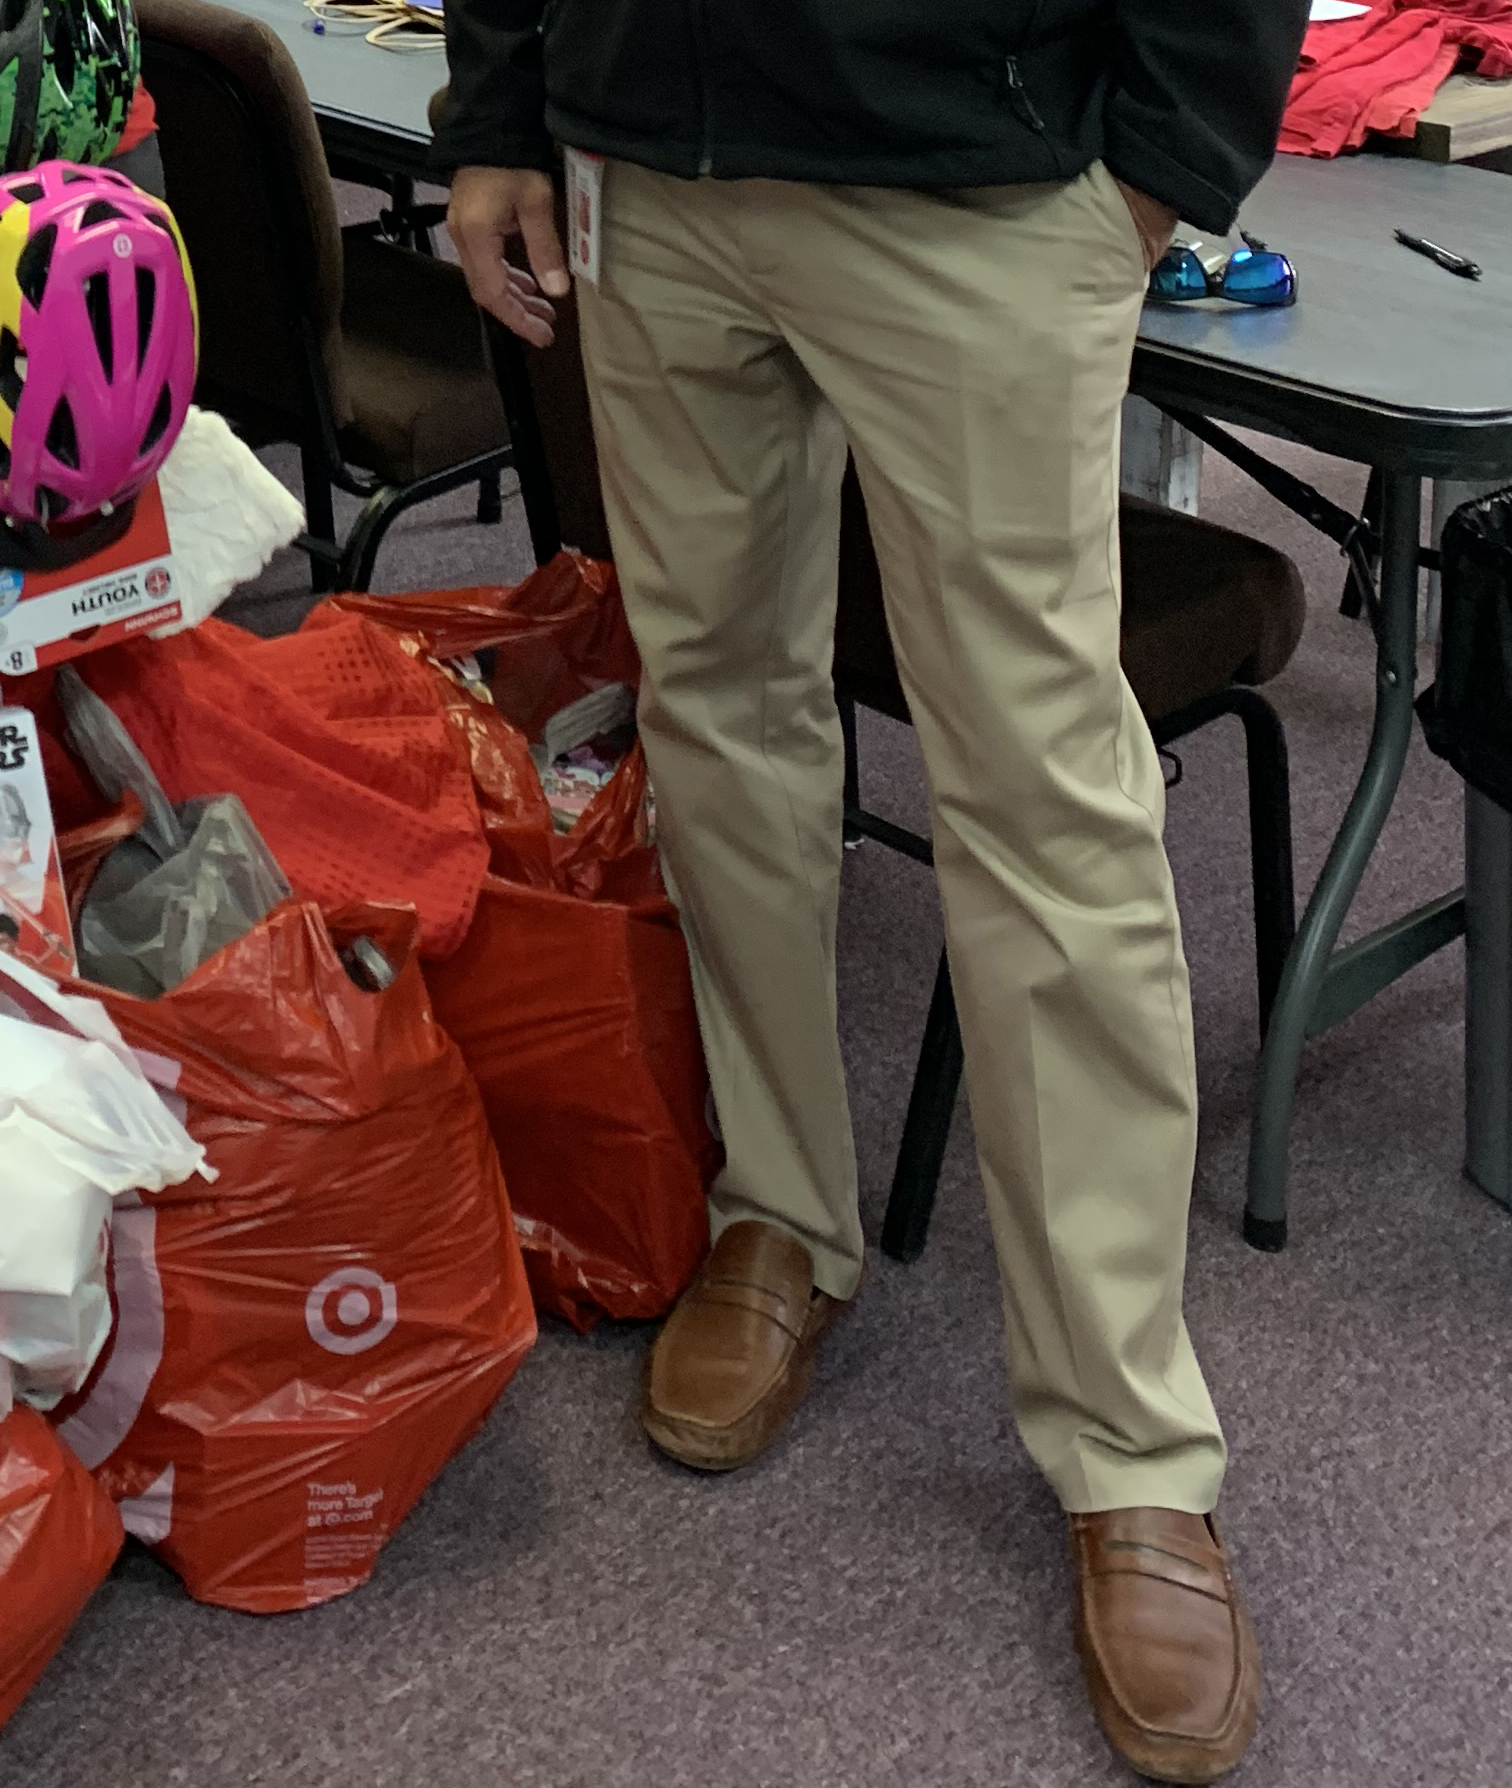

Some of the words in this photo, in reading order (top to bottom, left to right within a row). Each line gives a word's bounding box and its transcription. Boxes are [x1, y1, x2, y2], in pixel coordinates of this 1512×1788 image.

[70, 584, 141, 616] YOUTH
[307, 1480, 357, 1495] There's
[307, 1499, 344, 1511] more
[345, 1487, 384, 1509] Target
[307, 1514, 321, 1527] at
